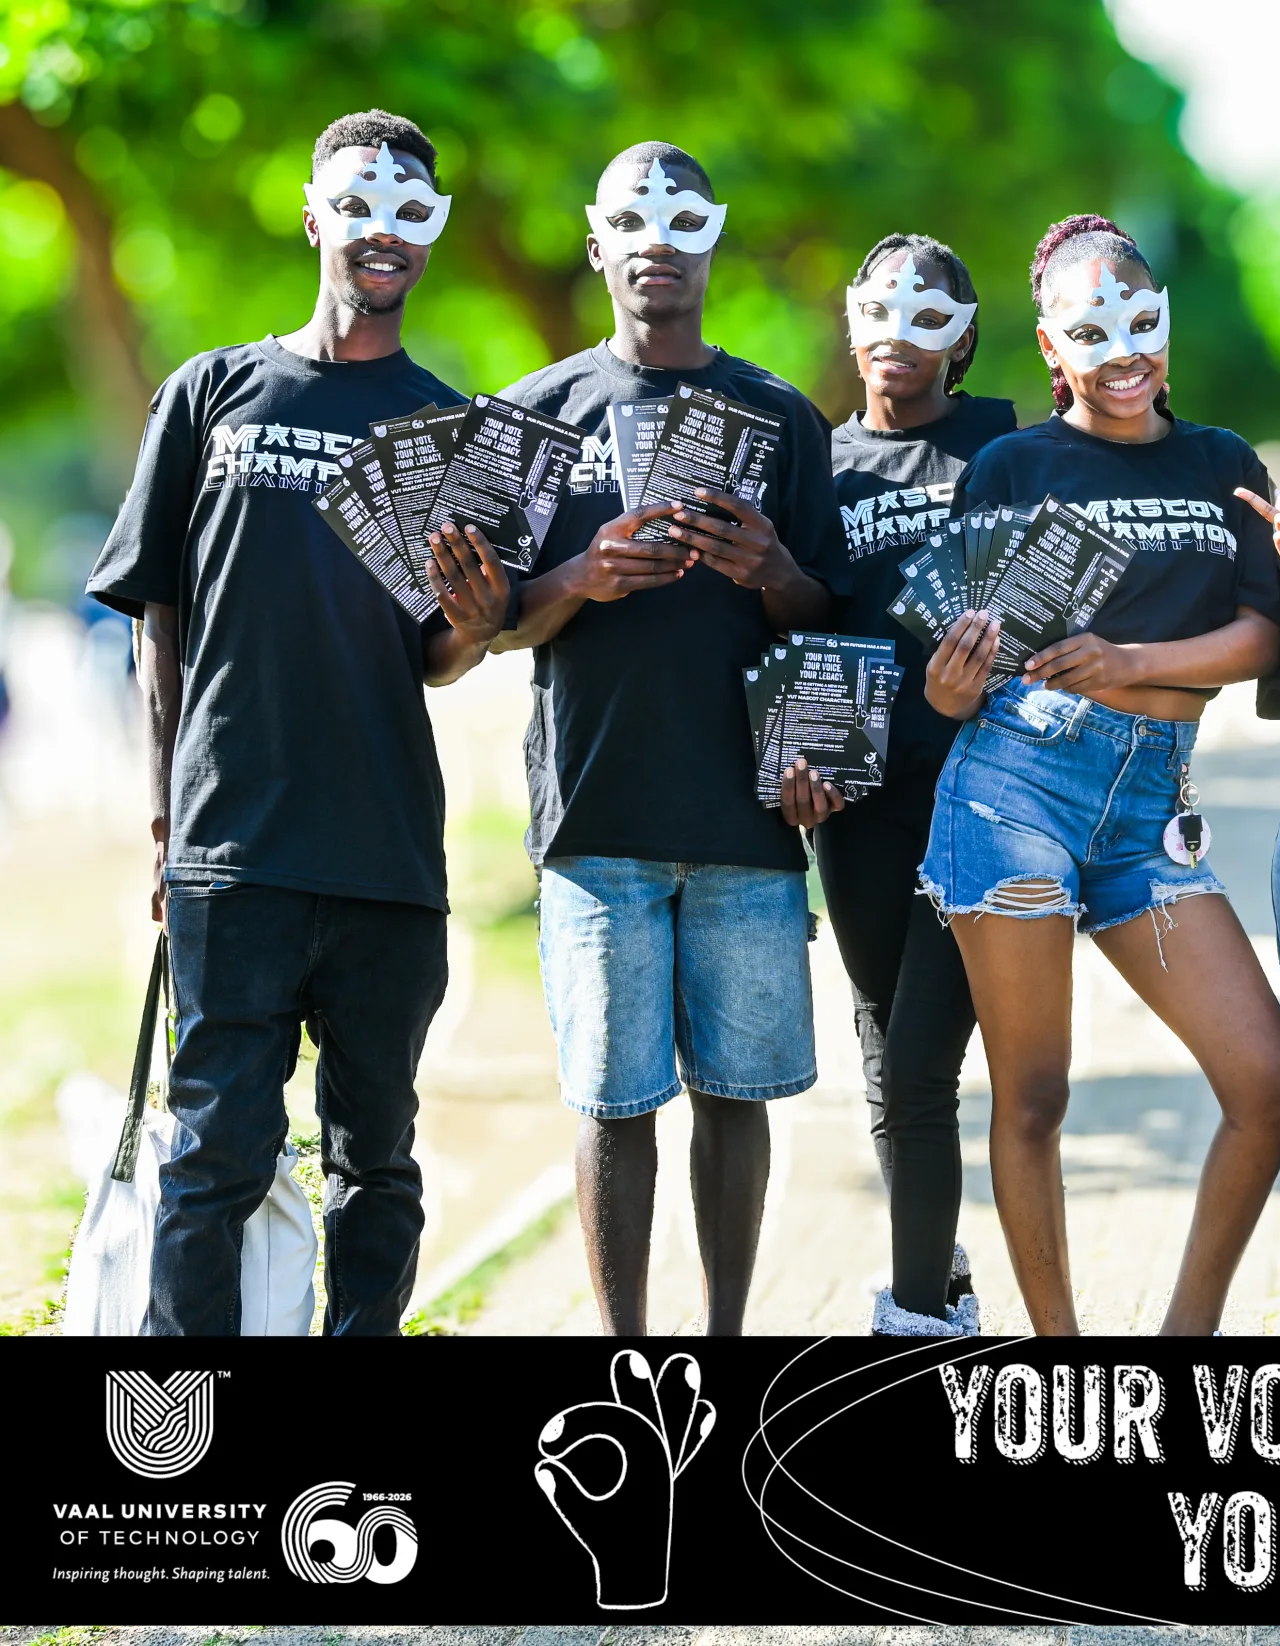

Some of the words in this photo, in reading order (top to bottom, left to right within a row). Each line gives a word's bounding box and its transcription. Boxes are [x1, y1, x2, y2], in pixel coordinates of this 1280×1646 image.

[485, 417, 504, 430] YOUR
[504, 424, 523, 438] VOTE.
[637, 422, 655, 430] YOUR
[684, 416, 702, 429] YOUR
[703, 423, 723, 437] VOICE.
[689, 407, 706, 420] YOUR
[708, 414, 725, 428] VOTE.
[212, 423, 366, 455] MASC
[393, 439, 413, 450] YOUR
[413, 435, 435, 446] VOTE.
[474, 433, 492, 447] YOUR
[493, 440, 521, 457] LEGACY.
[480, 425, 499, 439] YOUR
[500, 432, 521, 447] VOICE.
[635, 442, 653, 450] YOUR
[636, 432, 654, 440] YOUR
[679, 424, 697, 437] YOUR
[697, 431, 723, 447] LEGACY.
[394, 449, 414, 459] YOUR
[415, 444, 439, 455] VOICE.
[394, 459, 414, 469] YOUR
[415, 453, 444, 466] LEGACY.
[671, 449, 693, 459] MASCOT
[693, 456, 726, 471] CHARACTERS
[207, 451, 343, 481] CHAMP
[465, 458, 487, 469] MASCOT
[488, 467, 523, 482] CHARACTERS
[402, 484, 424, 492] MASCOT
[338, 497, 354, 513] YOUR
[343, 506, 360, 522] YOUR
[840, 482, 955, 531] MASC
[1065, 498, 1223, 522] MASCOT
[347, 515, 364, 531] YOUR
[846, 508, 951, 550] HAMP
[1044, 530, 1060, 545] YOUR
[1060, 540, 1078, 557] VOICE.
[1050, 522, 1066, 537] YOUR
[1066, 532, 1082, 548] VOTE.
[1098, 521, 1237, 552] AMPION
[1037, 536, 1054, 552] YOUR
[1052, 547, 1076, 566] LEGACY.
[1017, 554, 1026, 562] VUT
[1025, 560, 1044, 573] MASCOT
[1044, 571, 1072, 591] CHARACTERS
[803, 661, 820, 670] YOUR
[822, 663, 842, 672] VOICE.
[805, 652, 822, 661] YOUR
[824, 654, 842, 663] VOTE.
[800, 670, 817, 679] YOUR
[819, 672, 844, 681] LEGACY.
